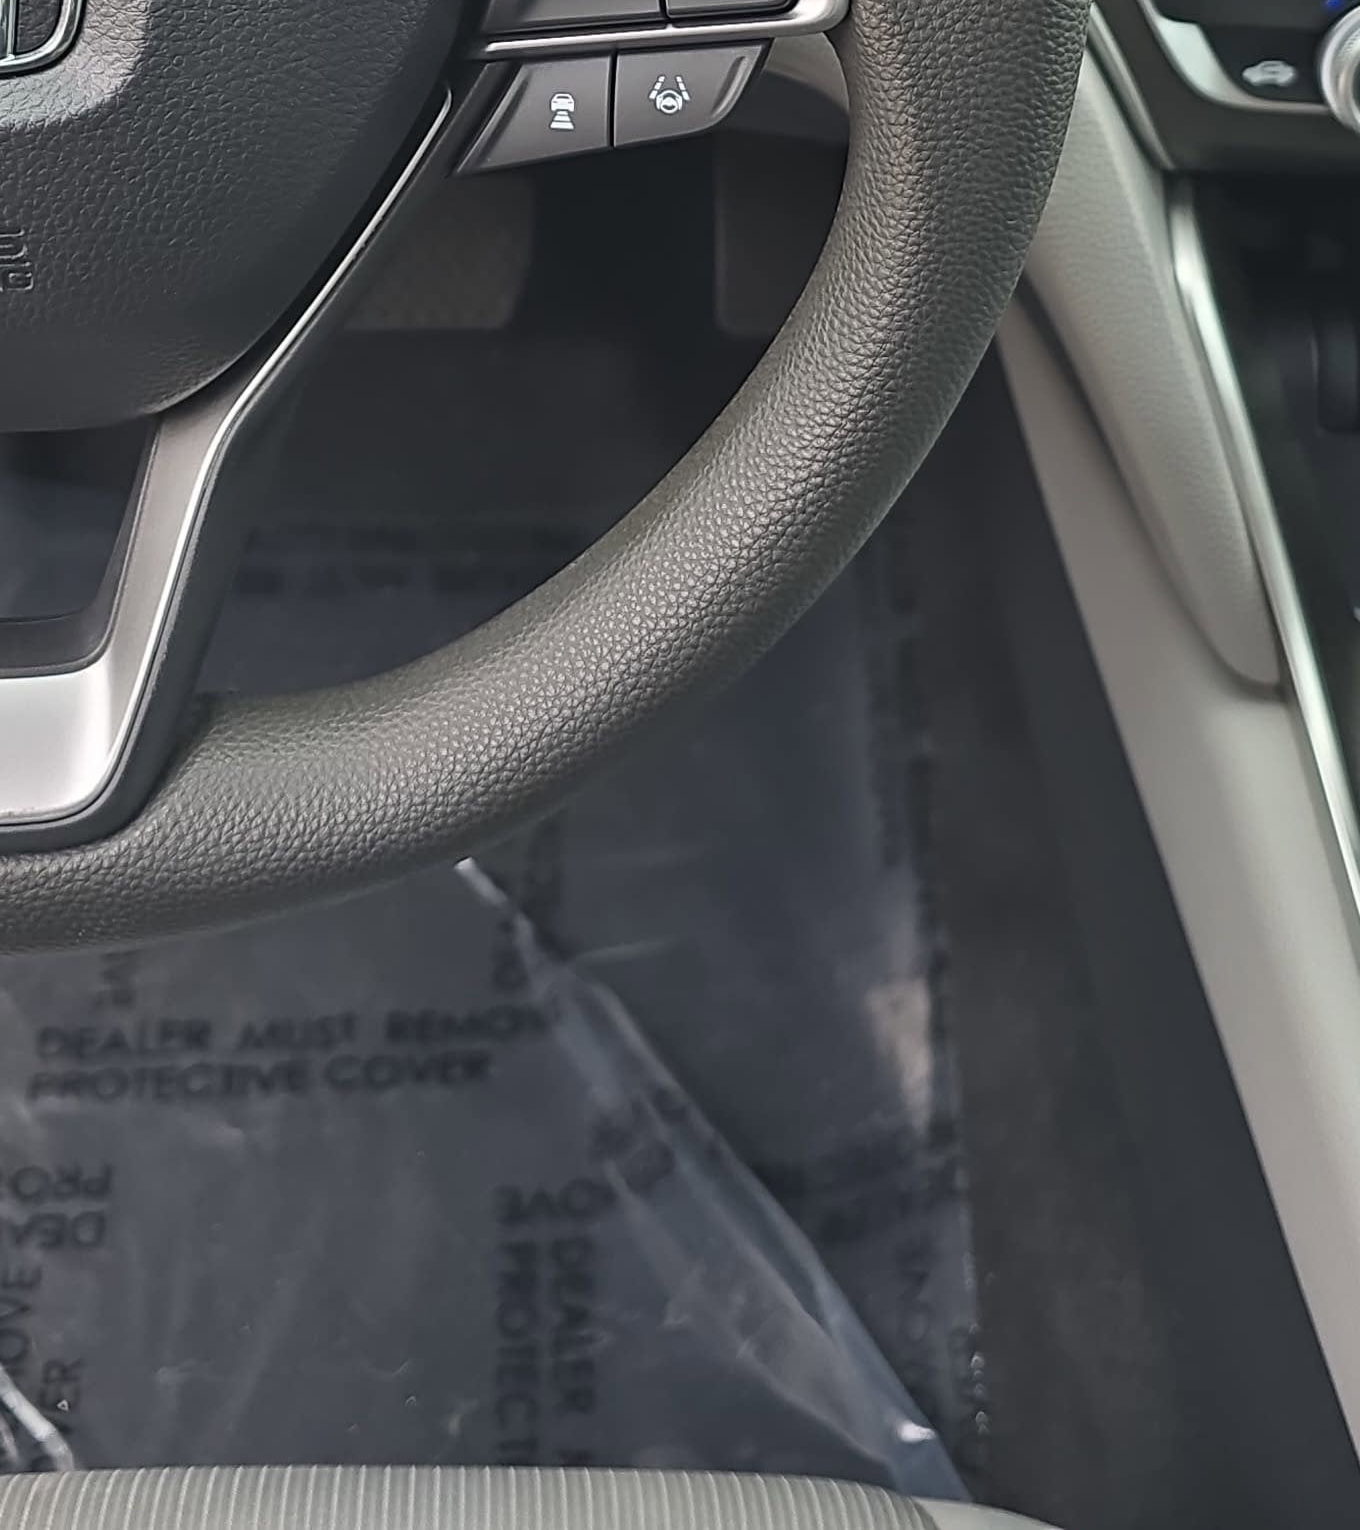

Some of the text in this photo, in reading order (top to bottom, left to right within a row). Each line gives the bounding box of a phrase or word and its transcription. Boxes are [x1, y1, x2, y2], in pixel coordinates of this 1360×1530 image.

[42, 1004, 547, 1060] DEALER MUST REMOV
[28, 1050, 492, 1103] PROTECTIVE COVER
